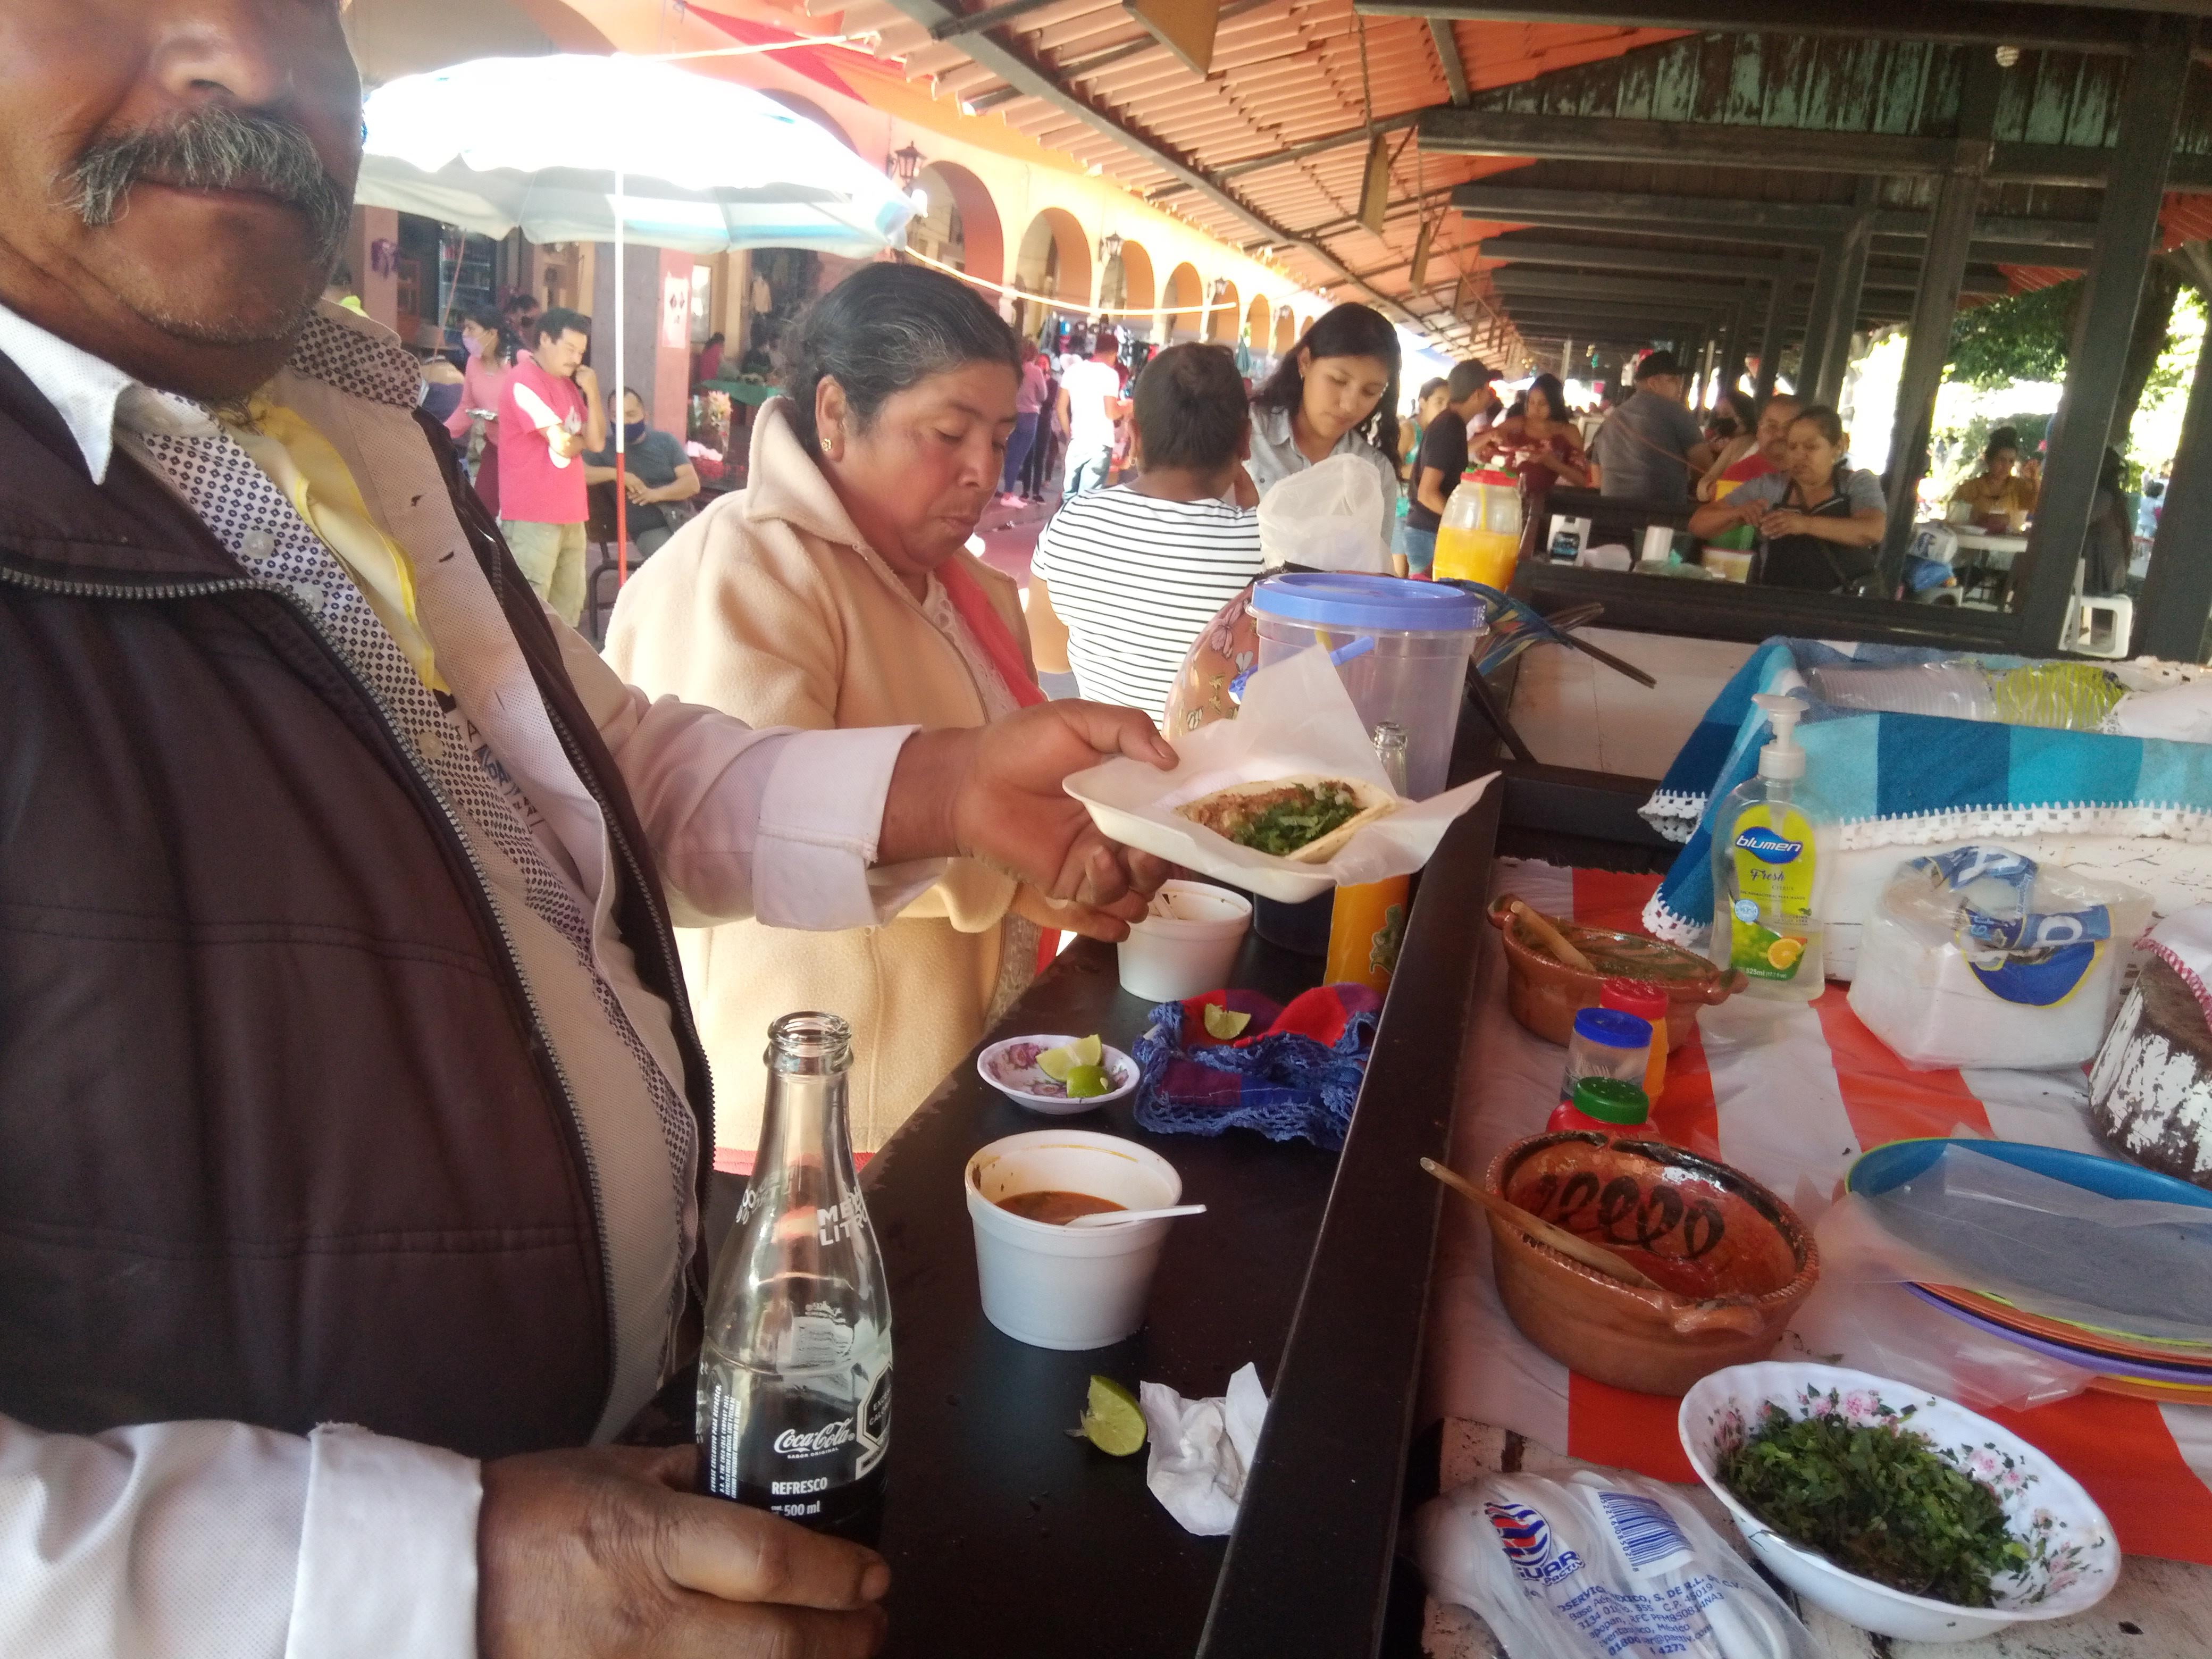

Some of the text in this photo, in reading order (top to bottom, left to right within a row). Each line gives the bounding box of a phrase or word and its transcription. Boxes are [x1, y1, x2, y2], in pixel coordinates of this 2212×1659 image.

[1736, 835, 1802, 852] blumen
[1750, 868, 1784, 881] Fresh
[1746, 968, 1765, 977] 525ml
[774, 1417, 853, 1454] Coca-Cola
[810, 1447, 839, 1457] ORIGINAL
[772, 1477, 828, 1495] REFRESCO
[784, 1504, 805, 1516] 500
[807, 1500, 820, 1515] ml
[1666, 1586, 1682, 1598] DE
[1663, 1600, 1682, 1612] C.P.
